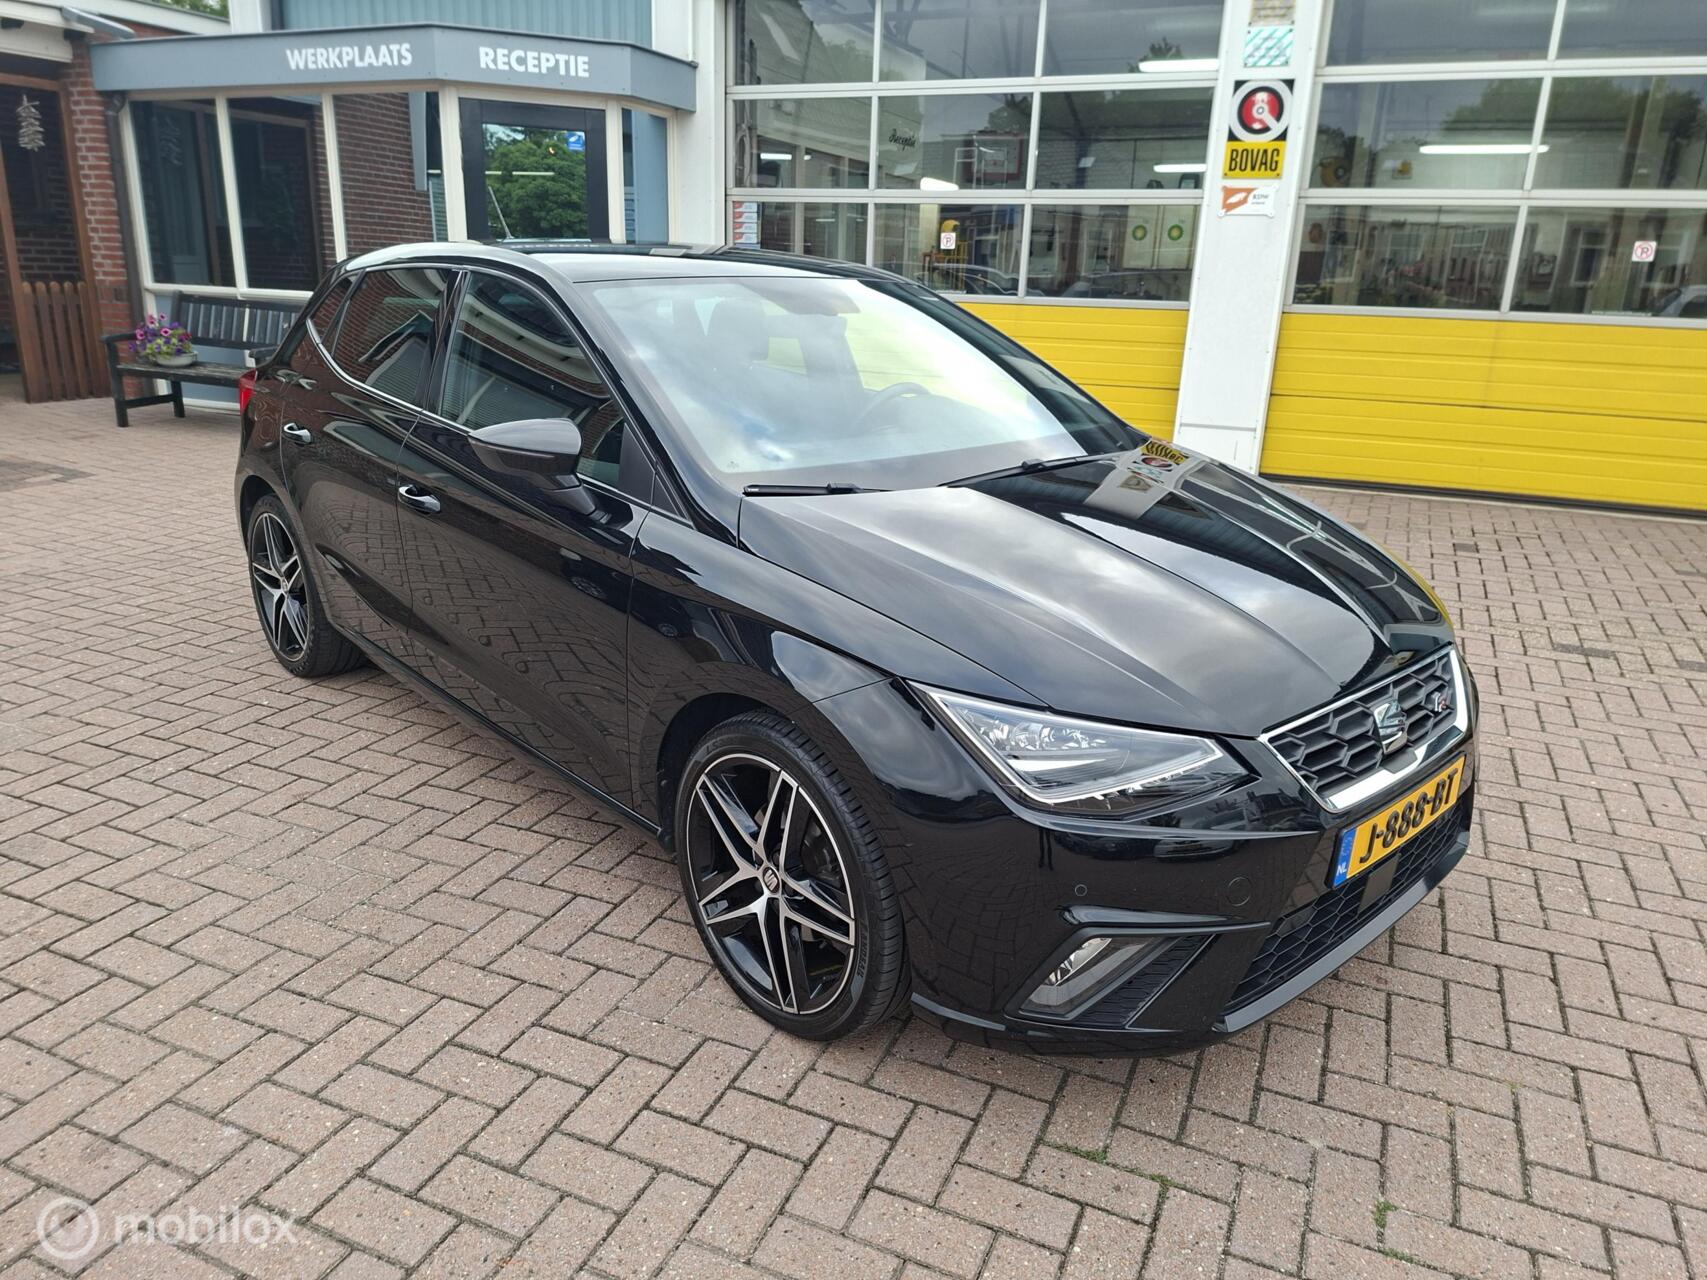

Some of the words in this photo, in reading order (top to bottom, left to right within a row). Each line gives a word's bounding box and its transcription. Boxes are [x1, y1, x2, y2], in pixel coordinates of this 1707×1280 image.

[286, 43, 413, 70] WERKPLAATS
[478, 46, 590, 78] RECEPTIE
[1228, 148, 1280, 172] BOVAG
[1358, 767, 1459, 865] J-888-BT
[1336, 861, 1348, 876] NL
